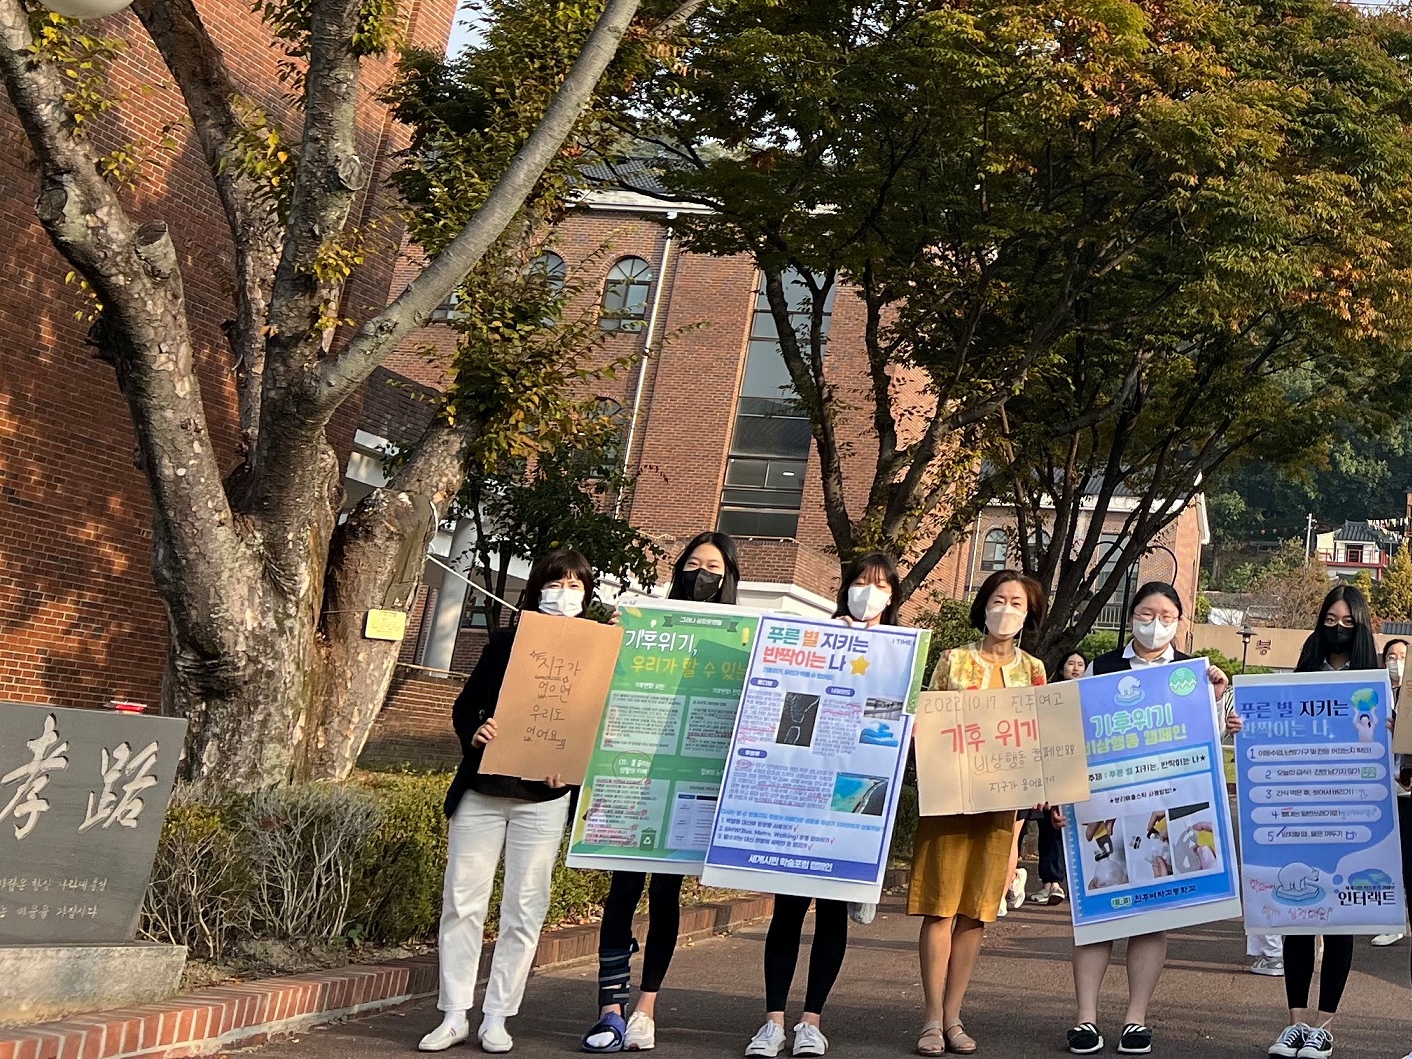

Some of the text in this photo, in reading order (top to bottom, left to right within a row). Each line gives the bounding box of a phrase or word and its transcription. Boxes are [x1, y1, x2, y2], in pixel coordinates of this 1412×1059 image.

[625, 629, 698, 656] 기후위기,
[767, 626, 800, 645] 푸른
[802, 630, 820, 647] 별
[820, 632, 869, 654] 지키는
[631, 656, 677, 674] 우리가
[683, 657, 698, 678] 할
[703, 661, 716, 677] 수
[762, 646, 846, 671] 반짝이는 나
[1011, 692, 1064, 713] 진주여고
[1240, 700, 1350, 718] 푸른 별 지키는
[530, 705, 565, 722] 우리도
[1090, 703, 1173, 738] 기후위기
[940, 719, 1037, 754] 기후 위기
[1145, 723, 1187, 746] 캠페인
[975, 750, 1026, 772] 비상행동
[1089, 771, 1102, 782] 주제
[1109, 768, 1125, 778] 푸른
[1161, 757, 1190, 770] 반짝이는
[1265, 769, 1272, 780] 2
[989, 779, 1016, 792] 지구가
[1266, 789, 1271, 799] 3
[1272, 809, 1278, 819] 4
[1268, 831, 1274, 842] 5
[748, 854, 778, 865] 세계시민
[780, 858, 809, 870] 학술포럼
[1134, 885, 1197, 904] 진주여자고등학교
